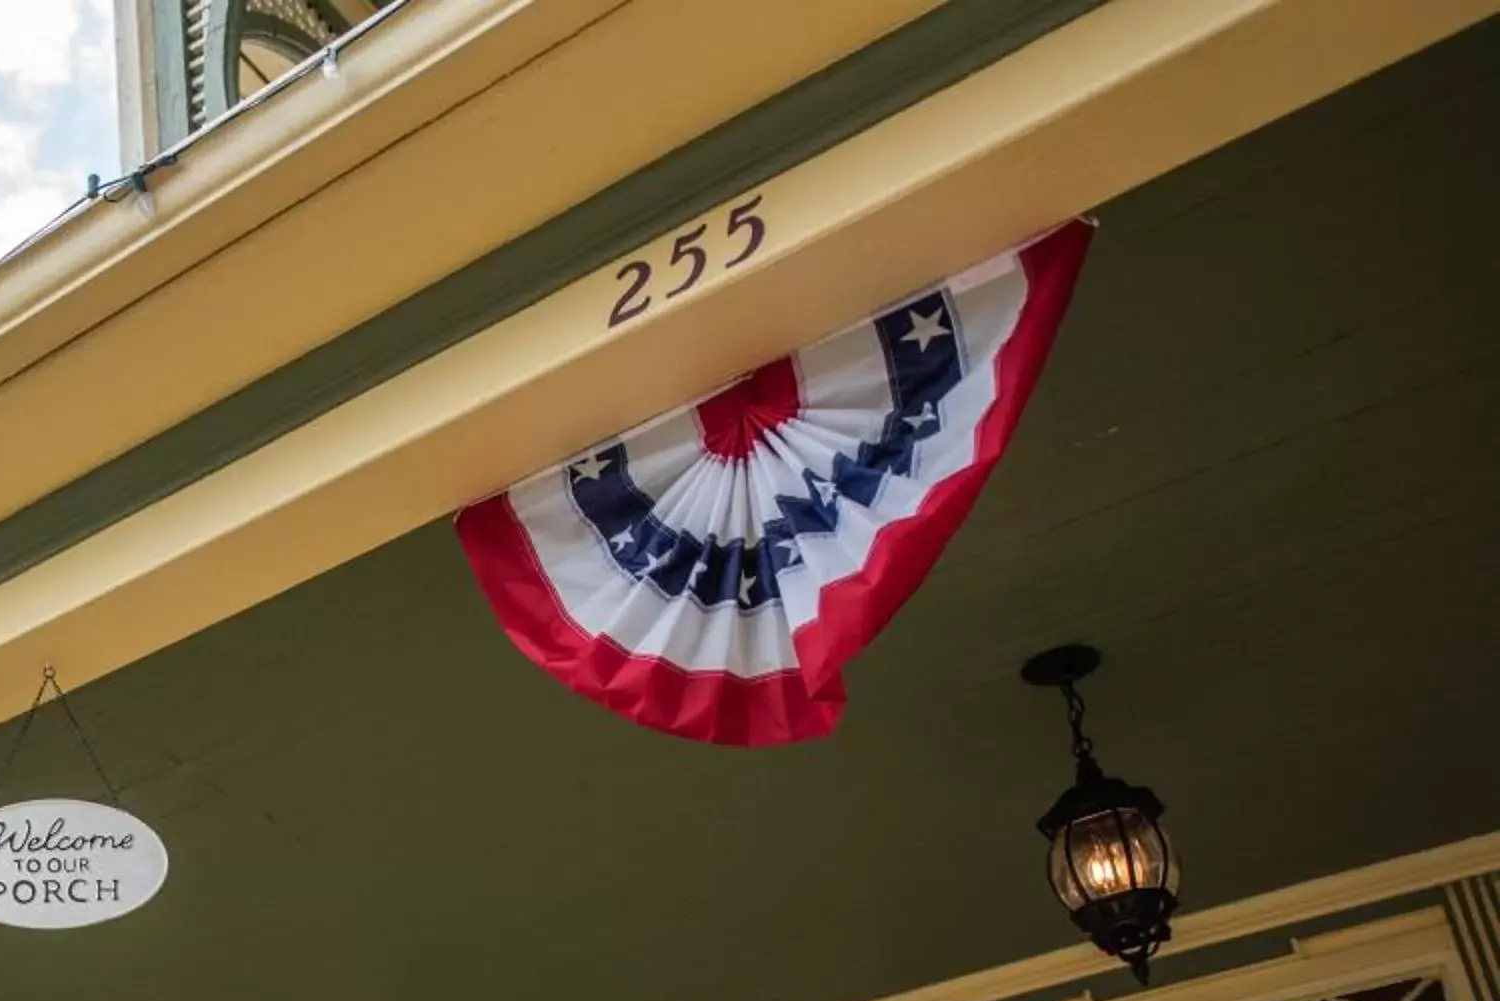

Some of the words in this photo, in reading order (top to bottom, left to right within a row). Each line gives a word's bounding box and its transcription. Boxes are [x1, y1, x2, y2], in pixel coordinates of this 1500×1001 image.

[608, 194, 765, 328] 255
[13, 858, 41, 874] TO
[47, 857, 90, 873] OUR
